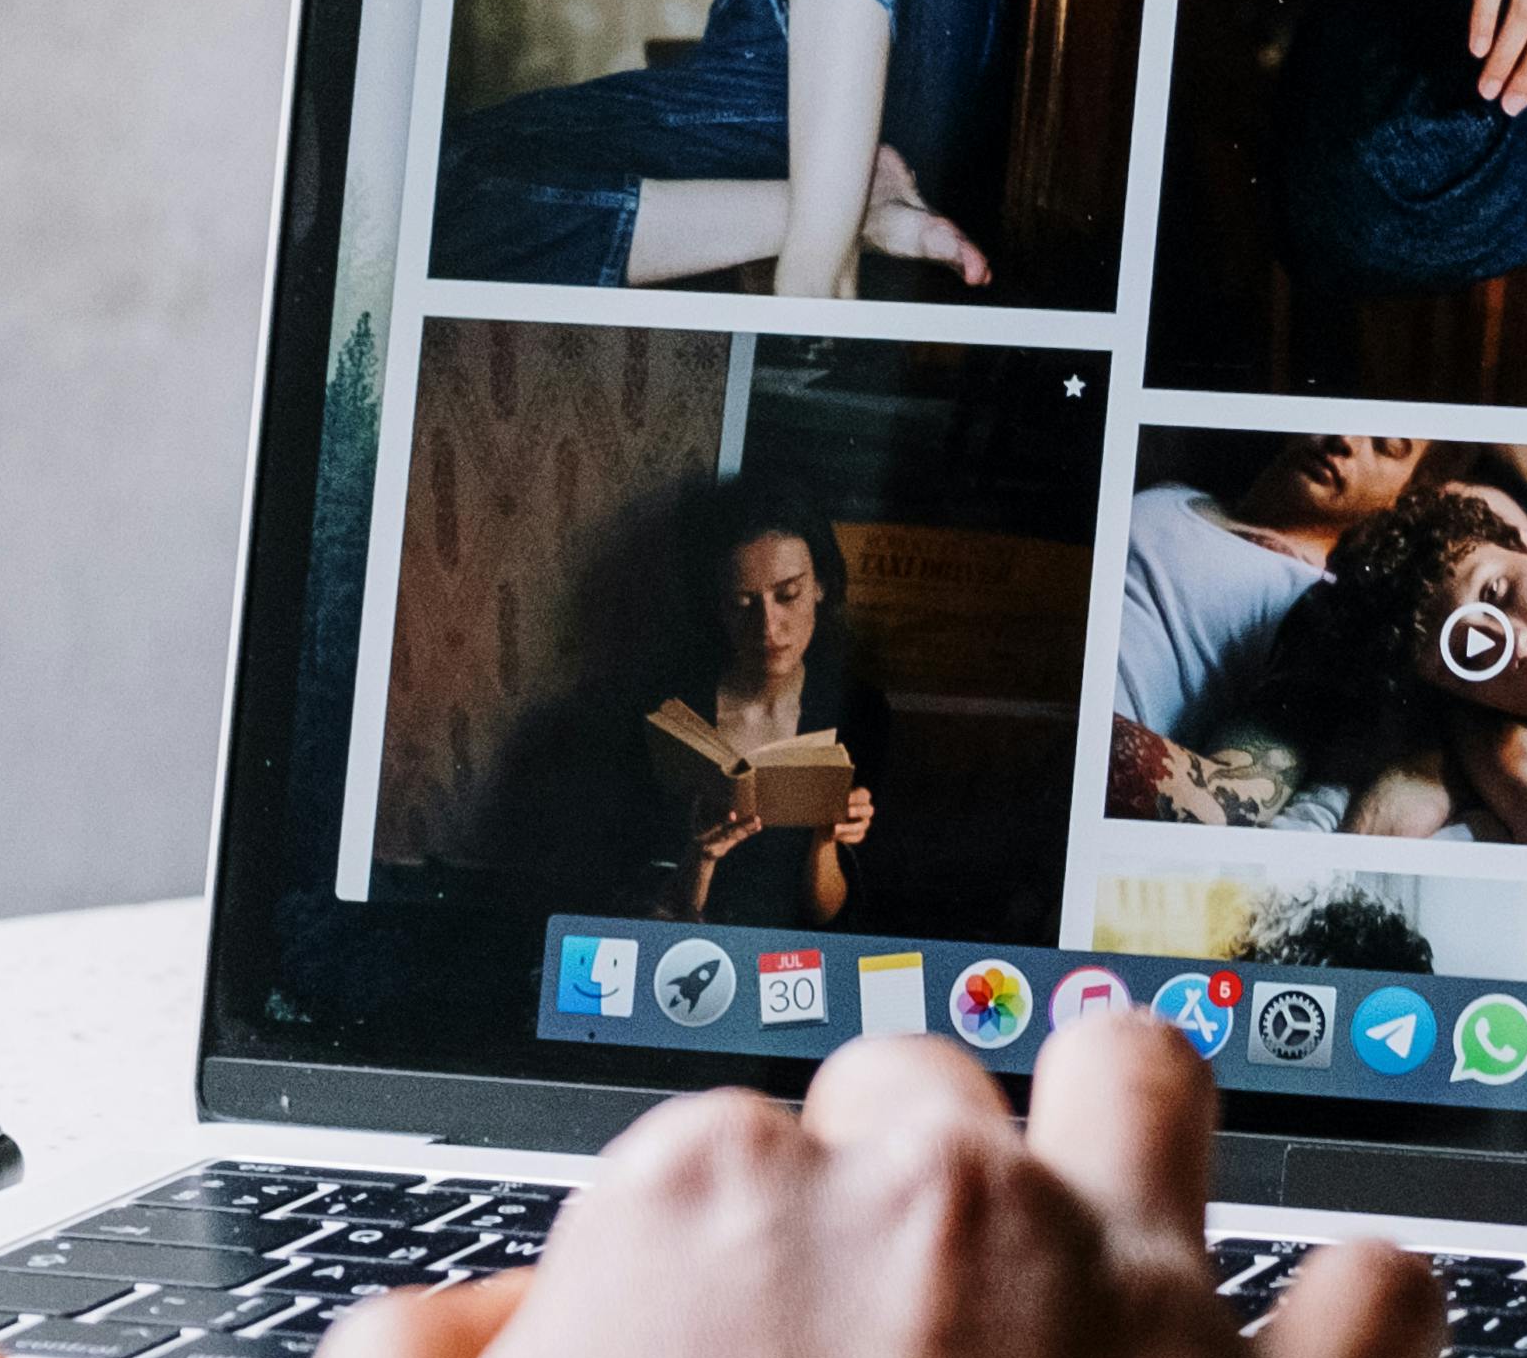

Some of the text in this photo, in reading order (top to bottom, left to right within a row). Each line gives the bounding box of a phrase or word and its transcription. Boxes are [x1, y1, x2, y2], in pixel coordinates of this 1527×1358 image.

[777, 954, 805, 970] JUL
[768, 977, 816, 1014] 30
[1219, 980, 1232, 1000] 5
[348, 1229, 384, 1244] Q
